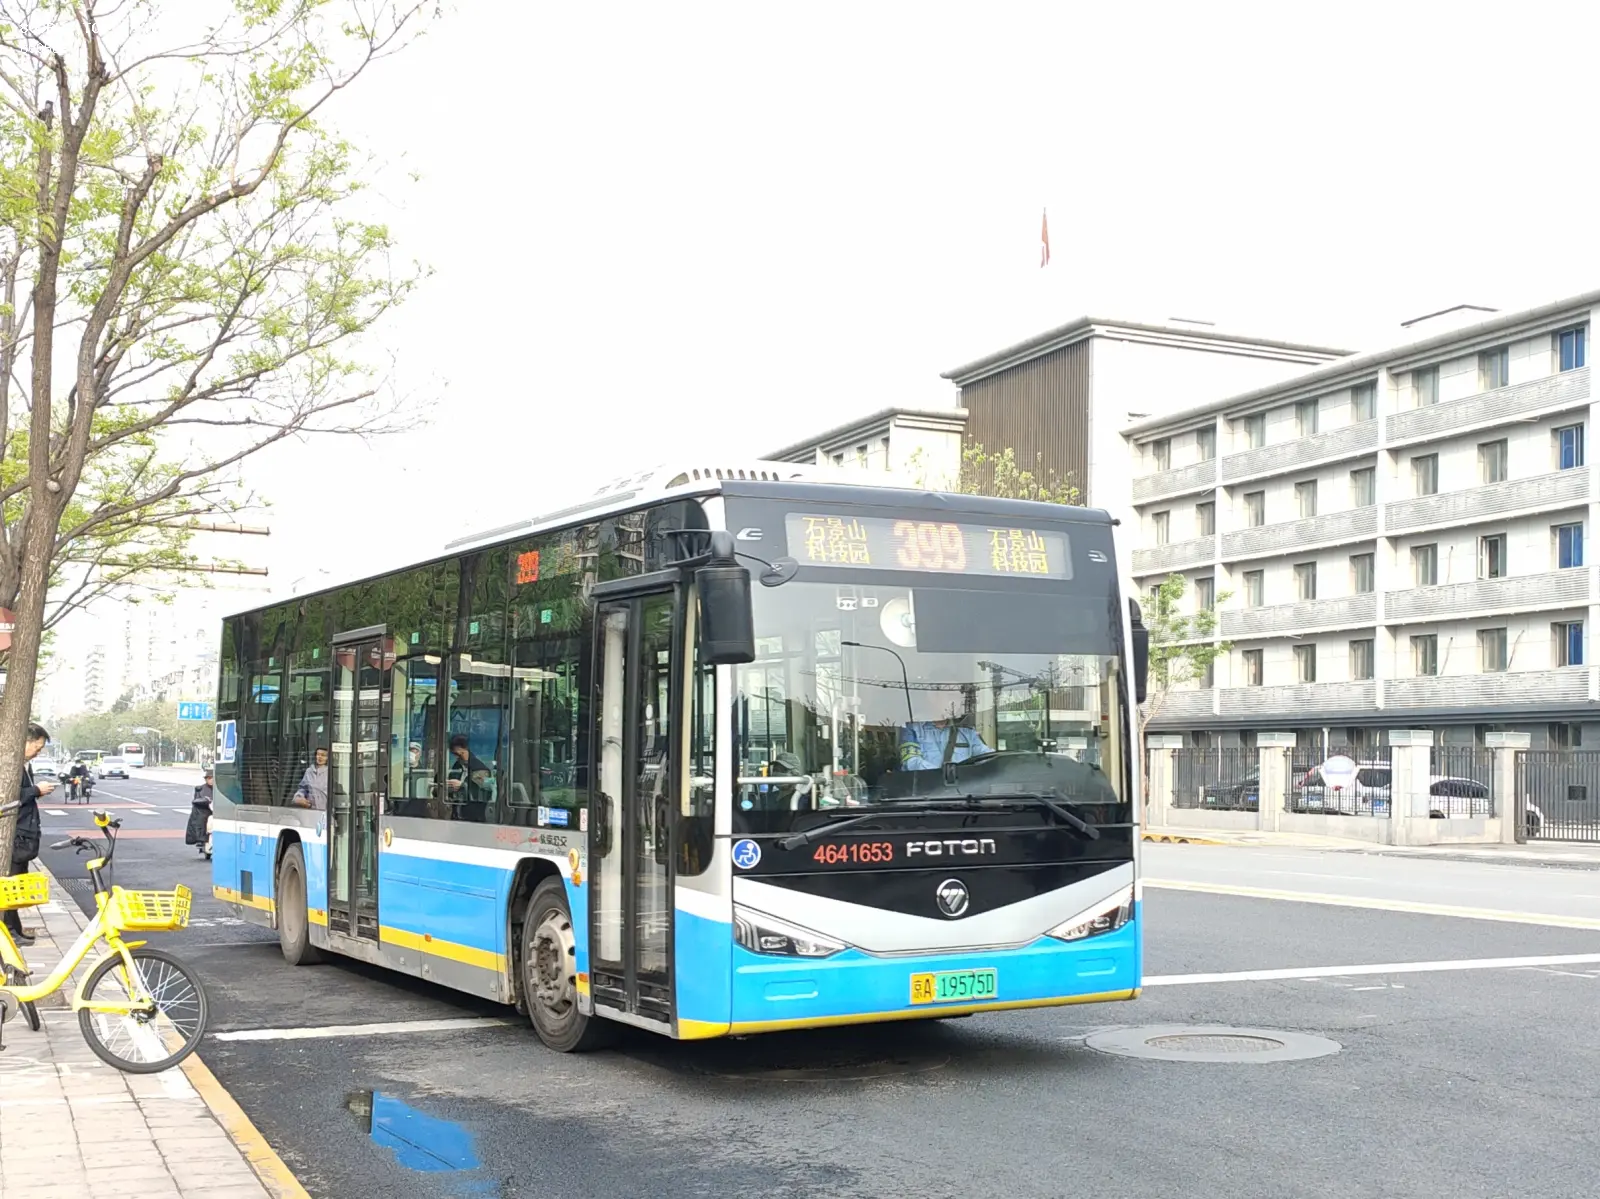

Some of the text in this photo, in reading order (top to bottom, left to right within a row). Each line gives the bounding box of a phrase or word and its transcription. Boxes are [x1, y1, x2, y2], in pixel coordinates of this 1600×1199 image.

[802, 517, 867, 541] 石景山
[987, 529, 1045, 552] 石景山
[805, 540, 870, 564] 科技园
[893, 520, 966, 569] 399
[991, 551, 1048, 574] 科技园
[813, 842, 893, 864] 4641653
[906, 839, 996, 857] FOTON
